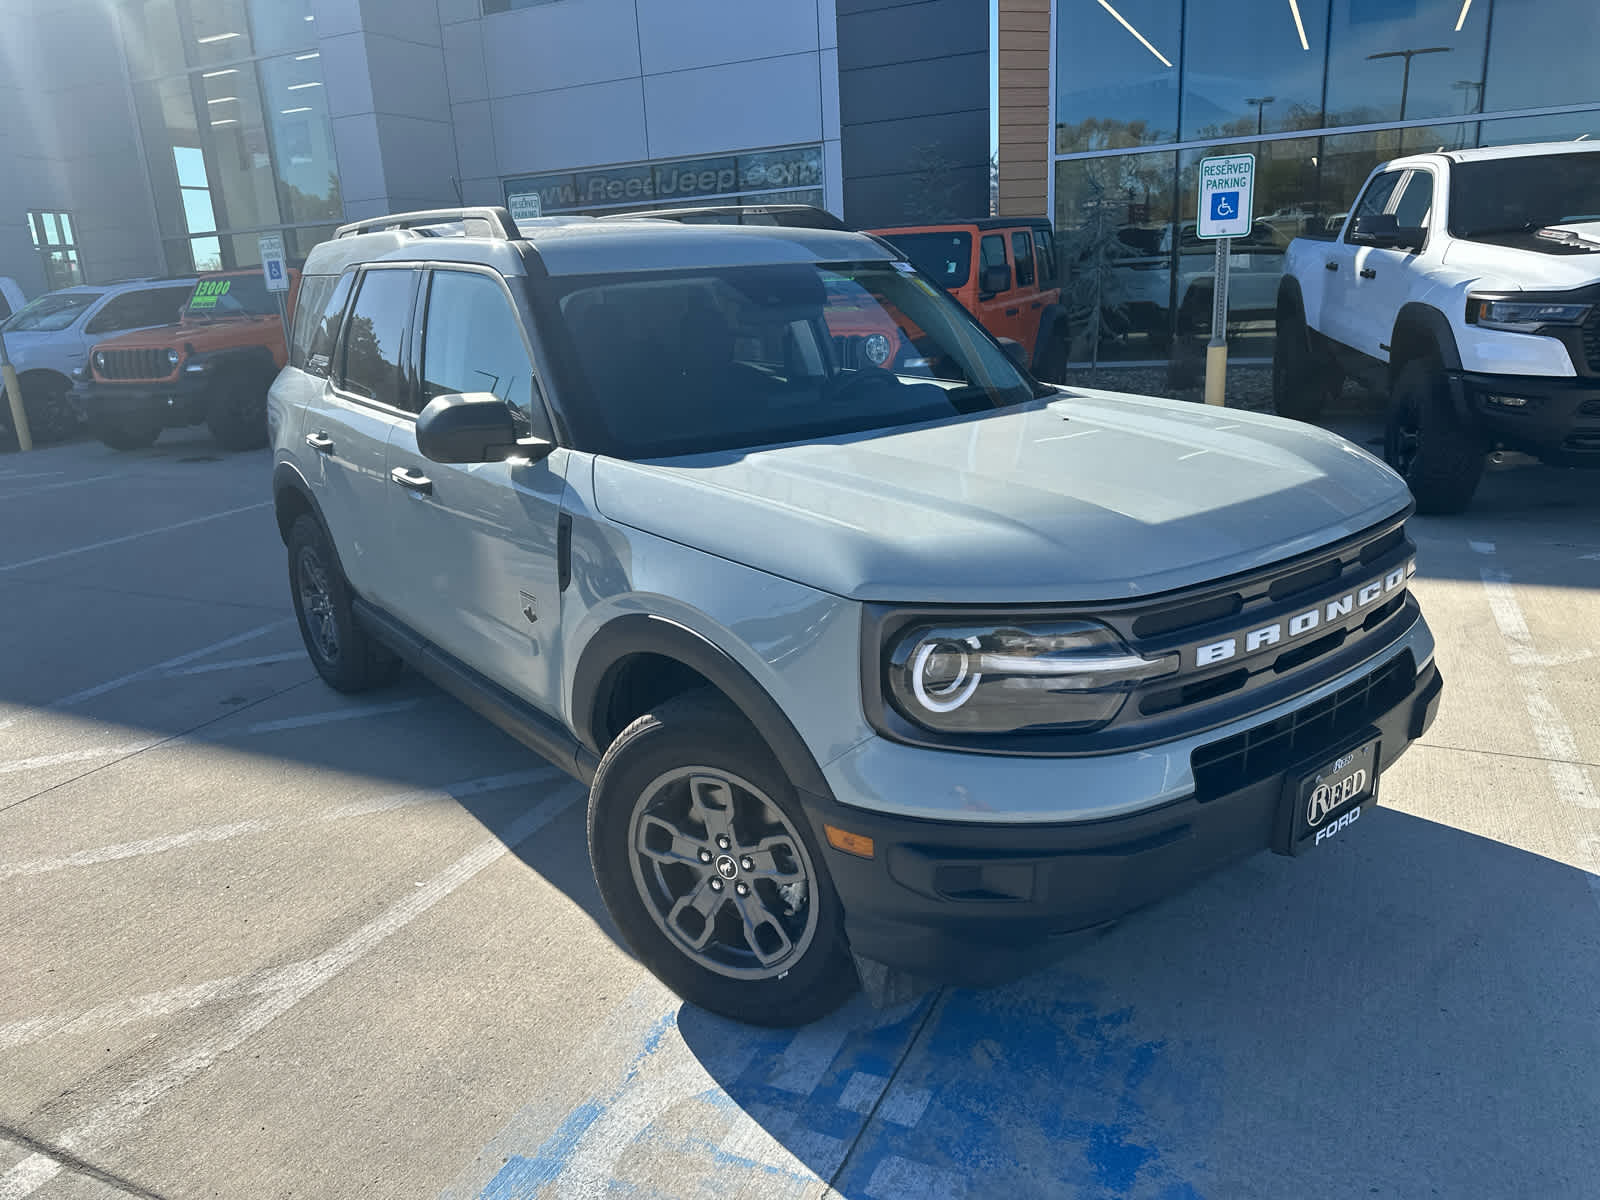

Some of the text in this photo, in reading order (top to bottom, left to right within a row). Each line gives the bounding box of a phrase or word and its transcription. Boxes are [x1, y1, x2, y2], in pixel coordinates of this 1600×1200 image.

[1204, 162, 1251, 176] RESERVED
[1206, 177, 1247, 190] PARKING
[1196, 567, 1404, 667] BRONCO
[1307, 769, 1366, 827] REED
[1315, 806, 1361, 846] FORD
